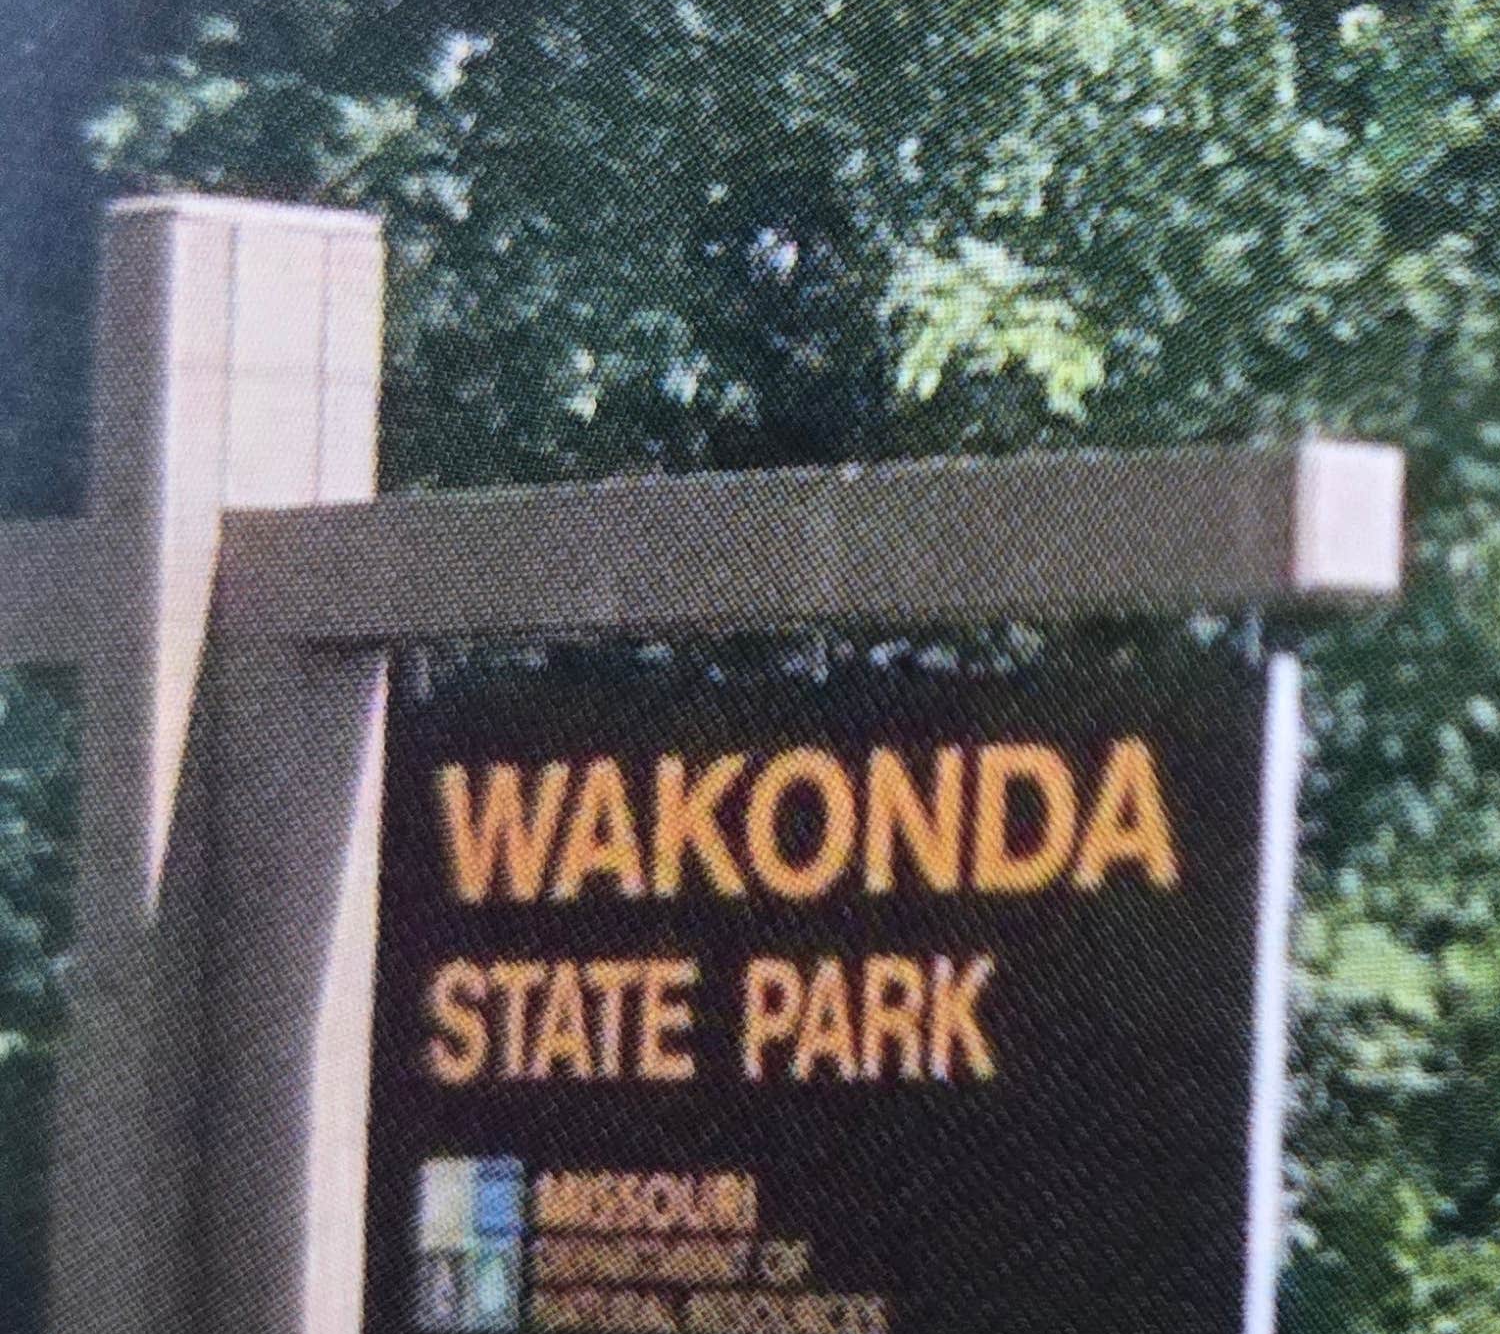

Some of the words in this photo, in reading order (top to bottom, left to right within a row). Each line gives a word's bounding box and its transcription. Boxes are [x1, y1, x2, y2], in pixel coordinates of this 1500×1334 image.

[440, 737, 1178, 905] WAKONDA
[430, 957, 697, 1081] STATE
[741, 953, 998, 1082] PARK
[533, 1169, 758, 1233] MISSOURI
